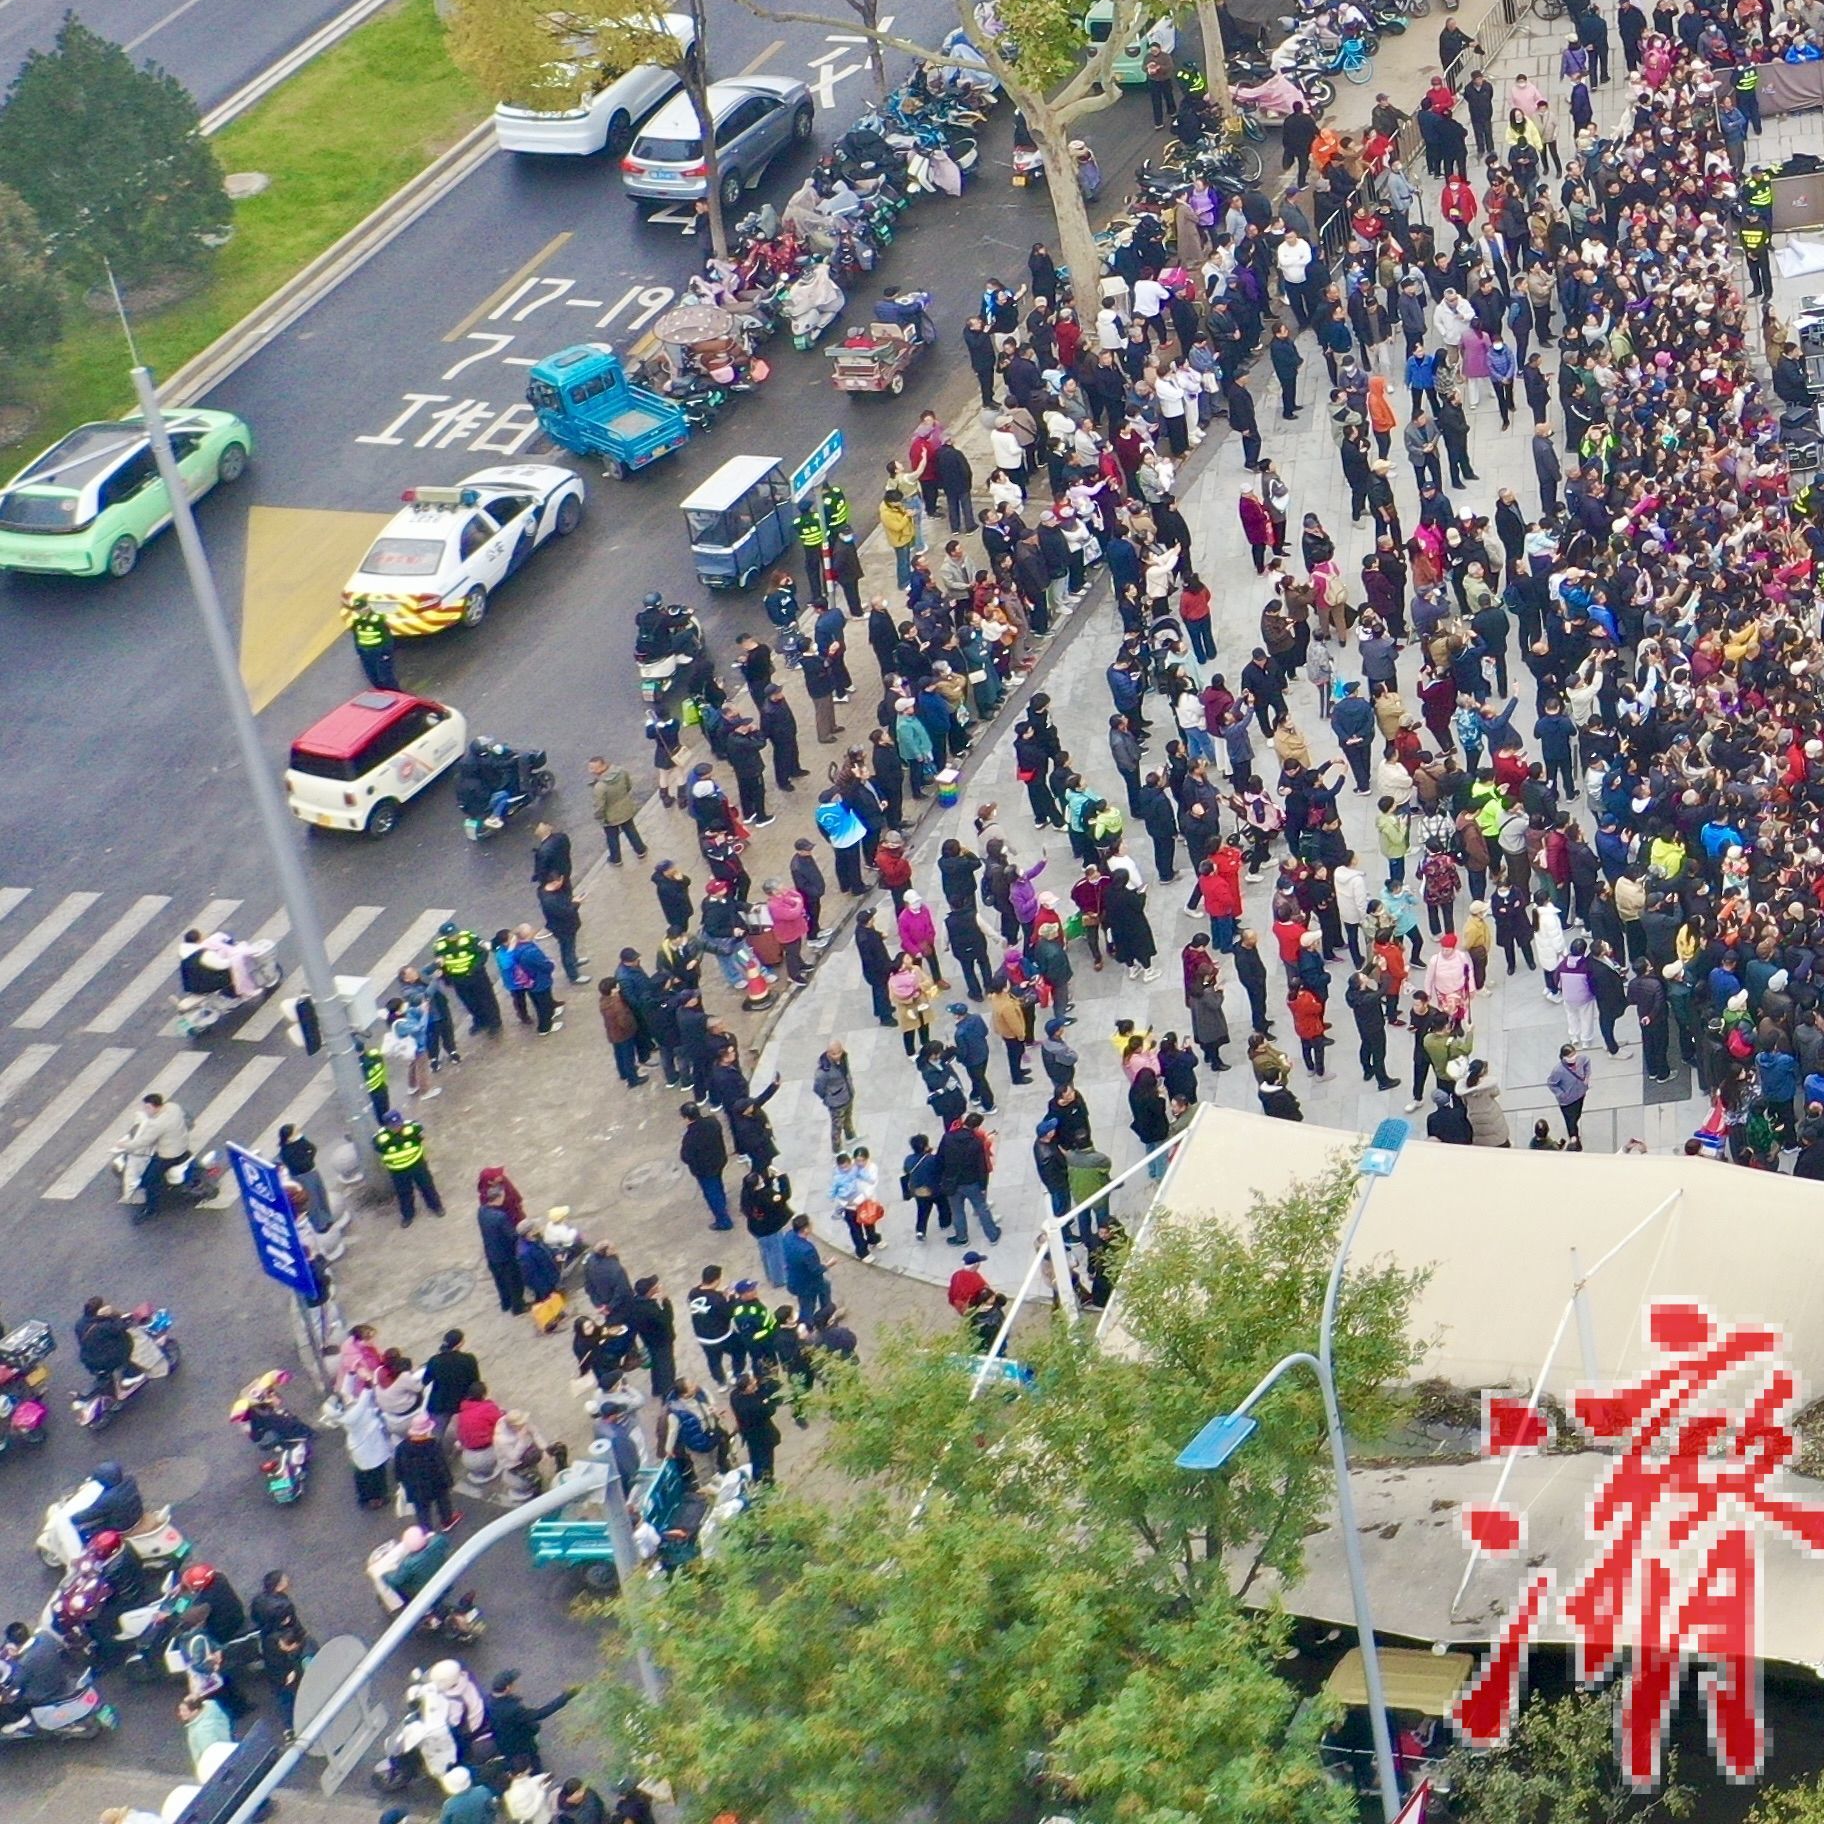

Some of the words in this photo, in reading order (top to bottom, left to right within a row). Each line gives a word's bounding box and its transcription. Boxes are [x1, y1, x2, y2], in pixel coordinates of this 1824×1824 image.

[487, 276, 675, 331] 17-19
[355, 393, 539, 456] 工作日
